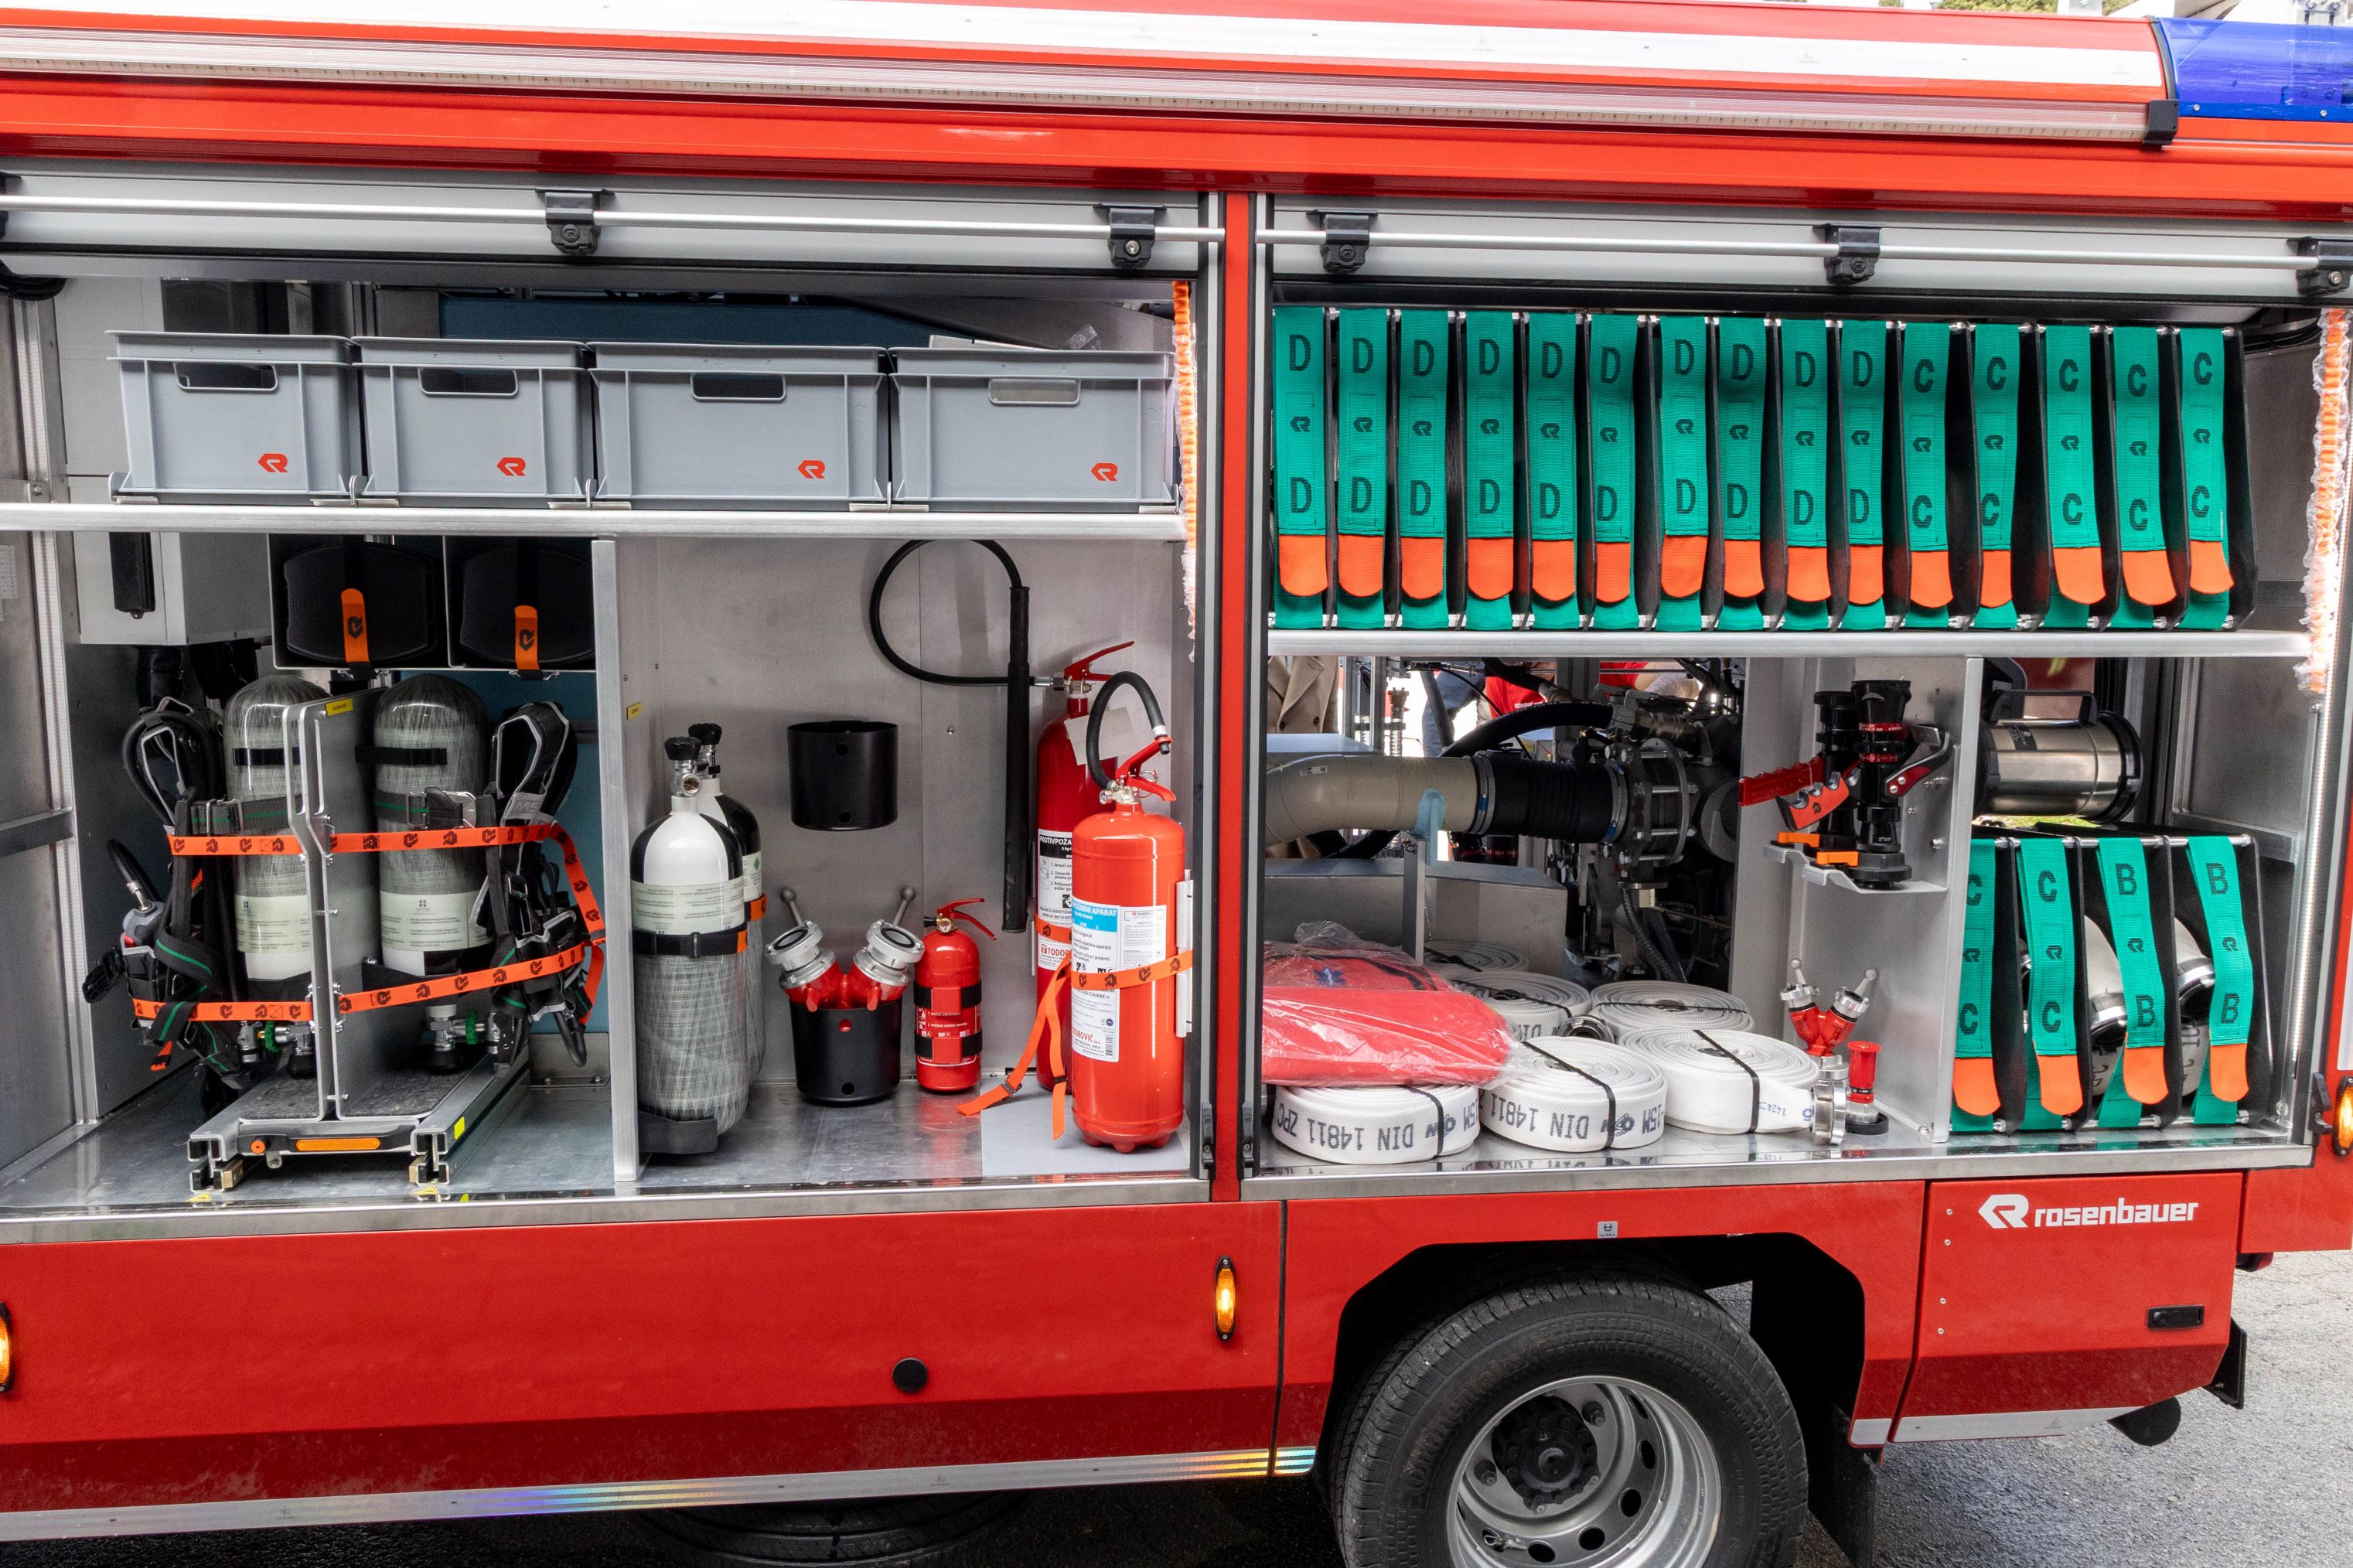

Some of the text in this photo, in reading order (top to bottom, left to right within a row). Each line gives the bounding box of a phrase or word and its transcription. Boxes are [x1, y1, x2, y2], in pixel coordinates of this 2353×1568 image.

[1290, 333, 1312, 372] D
[1353, 337, 1375, 374] D
[1413, 339, 1435, 378] D
[1479, 339, 1501, 377] D
[1541, 341, 1564, 381] D
[1600, 346, 1622, 385] D
[1675, 339, 1696, 377] D
[1732, 344, 1754, 381] D
[1795, 351, 1817, 388] D
[1851, 350, 1873, 387] D
[2194, 352, 2214, 386] C
[1914, 359, 1935, 394] C
[1986, 356, 2007, 391] C
[2059, 359, 2080, 393] C
[2128, 364, 2148, 398] C
[1291, 476, 1313, 513] D
[1351, 476, 1373, 513] D
[1410, 479, 1432, 516] D
[1479, 479, 1502, 515] D
[1540, 482, 1561, 520] D
[1596, 485, 1618, 522] D
[1676, 478, 1697, 515] D
[1727, 482, 1749, 519] D
[1793, 489, 1815, 526] D
[1850, 488, 1870, 524] D
[1912, 494, 1934, 529] C
[1980, 491, 2001, 528] C
[2062, 493, 2084, 526] C
[2191, 485, 2211, 518] C
[2130, 498, 2149, 532] C
[1966, 872, 1984, 906] C
[2038, 870, 2058, 903] C
[2116, 863, 2138, 896] B
[2206, 862, 2229, 895] B
[1091, 907, 1117, 917] APARAT
[1959, 1002, 1980, 1035] C
[2041, 1000, 2061, 1034] C
[2135, 995, 2155, 1028] B
[2221, 992, 2241, 1024] B
[1490, 1093, 1539, 1132] 14811
[1550, 1112, 1590, 1141] DIN
[1307, 1117, 1365, 1151] 14811
[1377, 1123, 1414, 1151] DIN
[2034, 1197, 2199, 1228] rosenbauer
